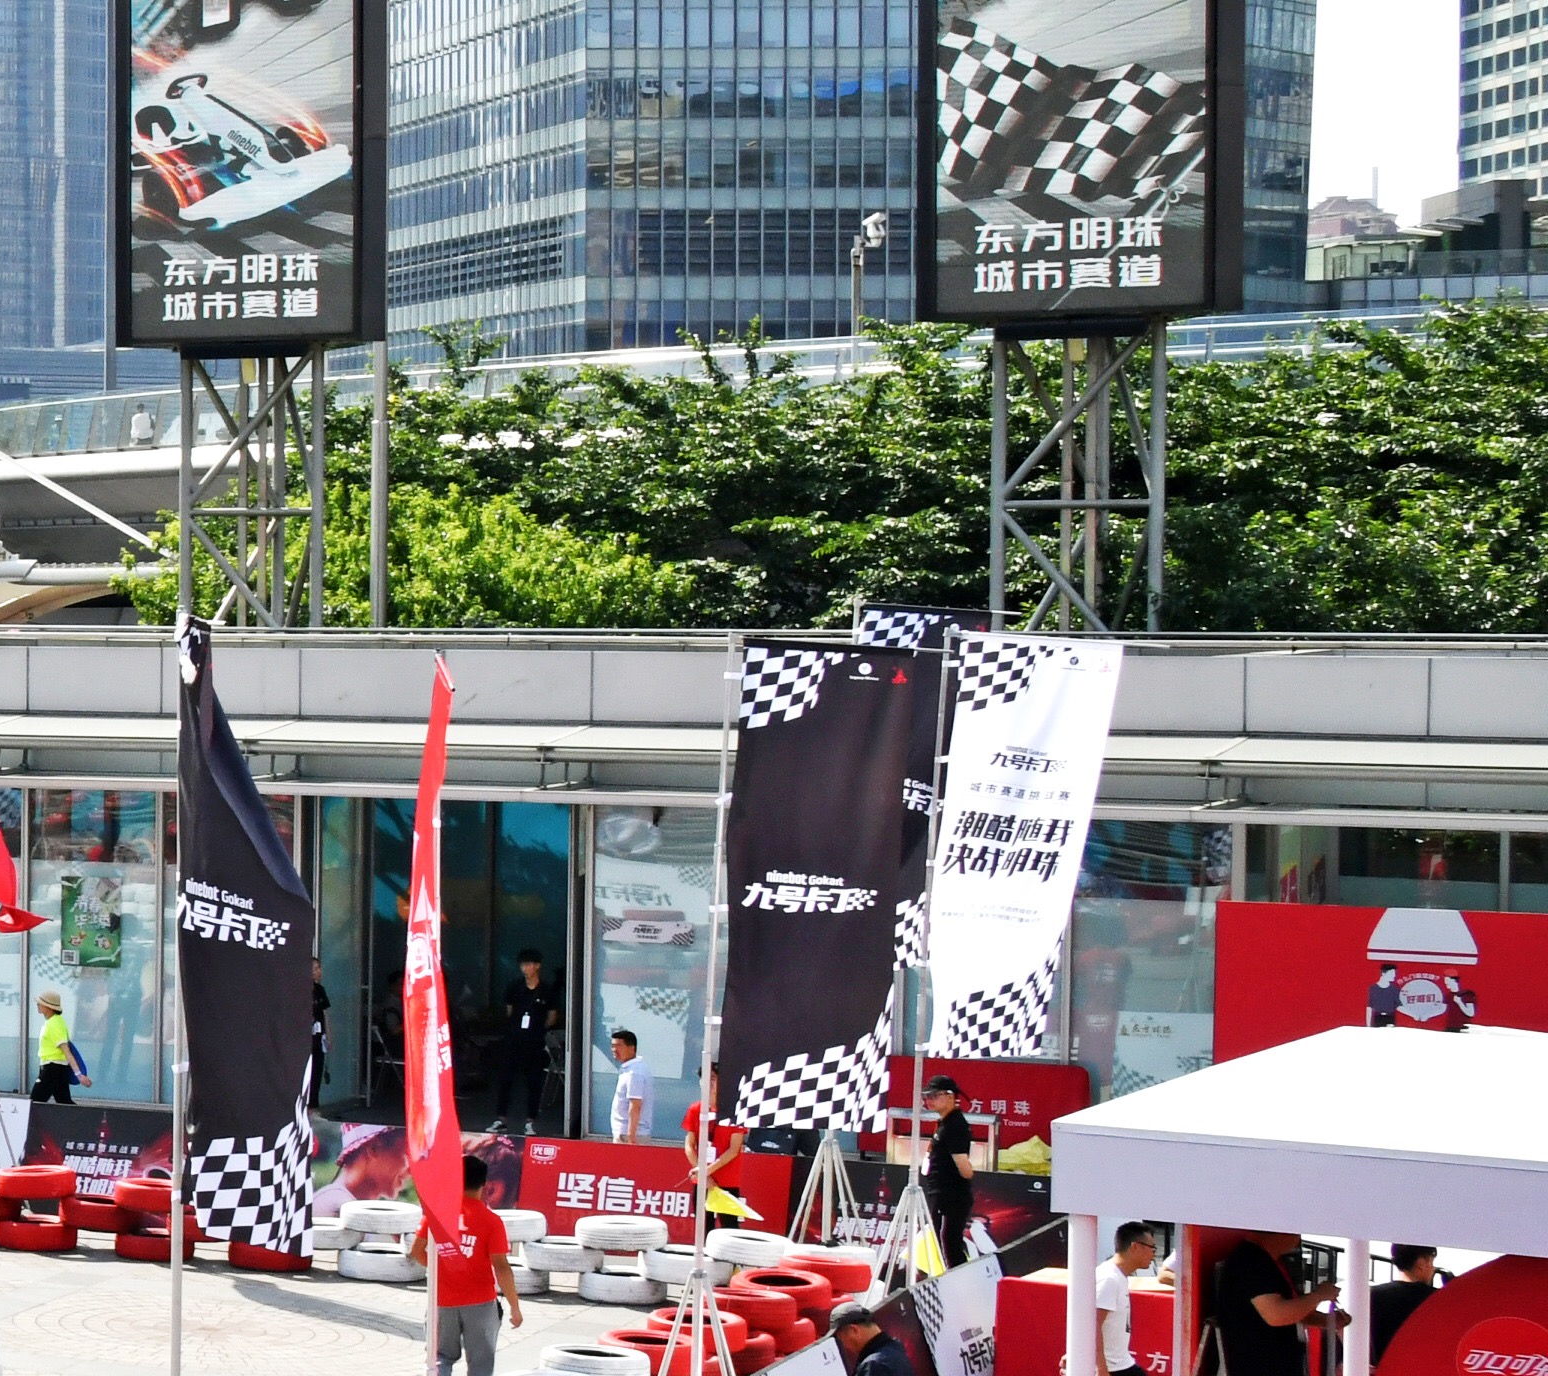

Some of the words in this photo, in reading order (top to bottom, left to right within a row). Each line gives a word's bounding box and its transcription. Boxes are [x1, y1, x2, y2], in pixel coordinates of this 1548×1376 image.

[226, 128, 263, 160] ninebot
[975, 216, 1162, 255] 东方明珠
[163, 253, 319, 285] 东方明珠
[974, 254, 1162, 293] 城市赛道
[163, 287, 319, 321] 城市赛道
[953, 810, 1074, 847] 潮酷随我
[766, 870, 807, 886] ninebot
[808, 874, 844, 887] Gokart
[941, 843, 1061, 883] 决战明珠
[185, 878, 219, 899] ninebot
[221, 890, 254, 910] Gokart
[741, 882, 853, 914] 九号卡丁
[956, 1098, 1031, 1117] 方明珠
[557, 1172, 696, 1219] 坚信光明
